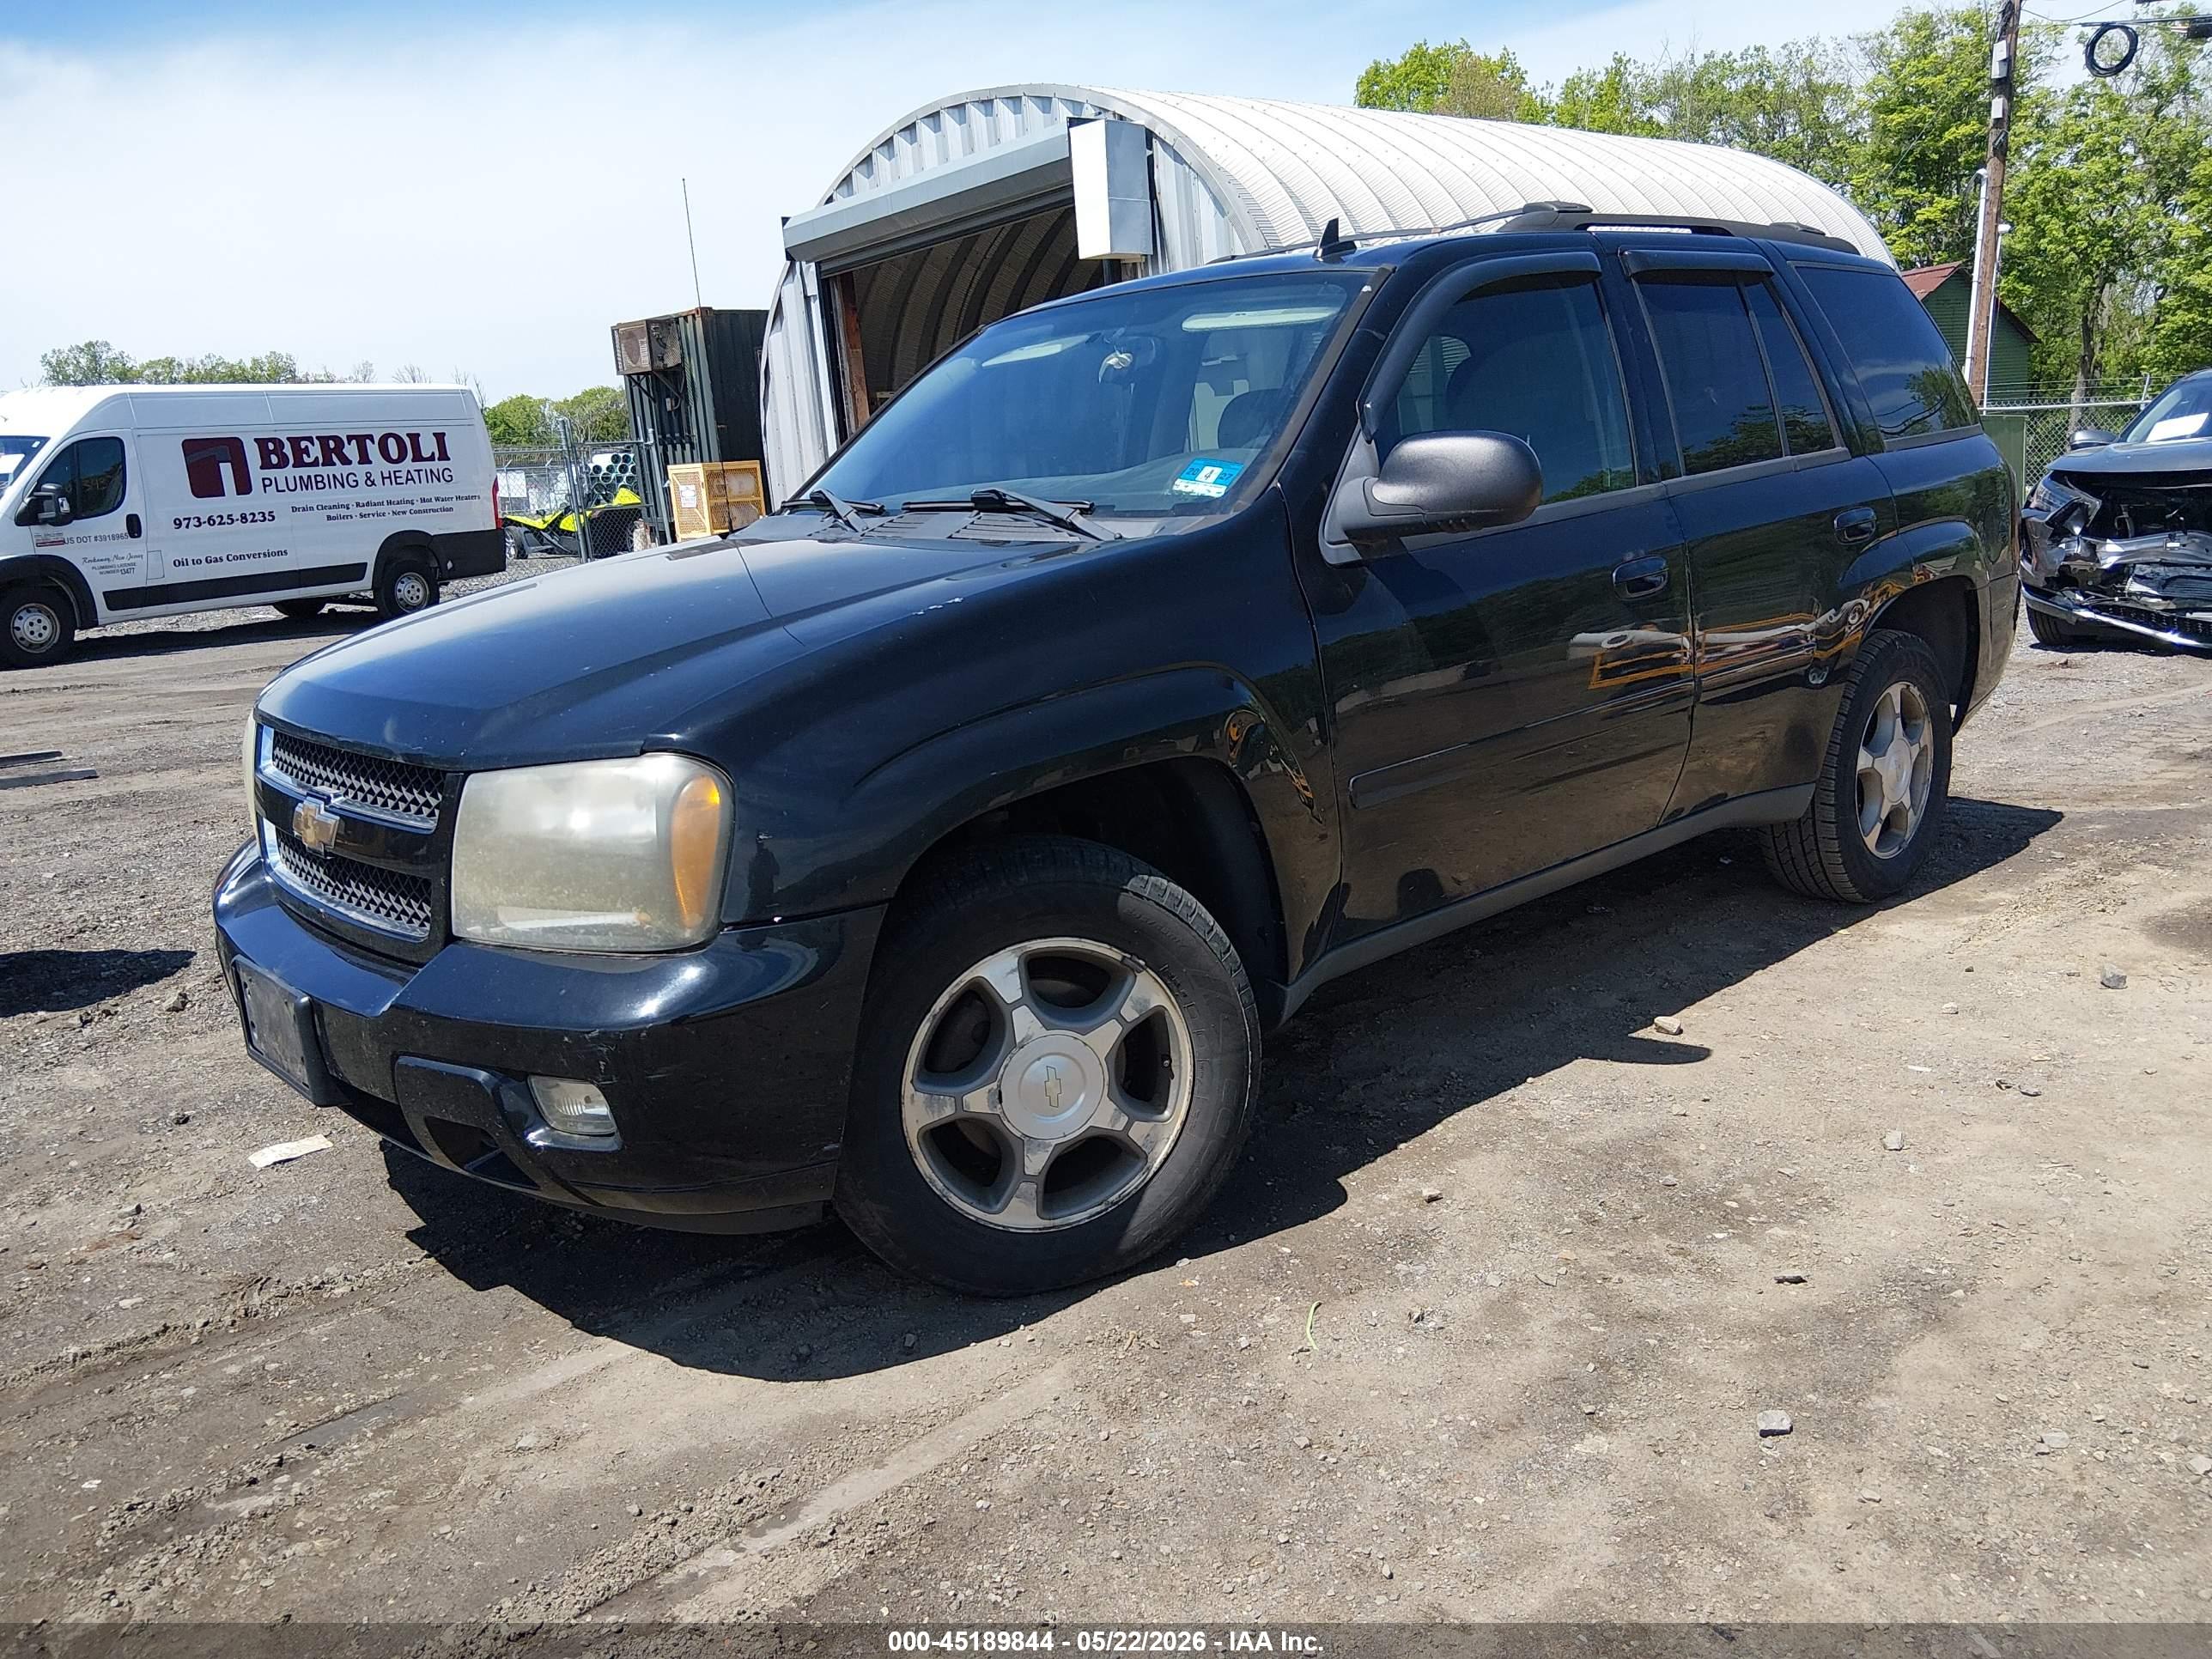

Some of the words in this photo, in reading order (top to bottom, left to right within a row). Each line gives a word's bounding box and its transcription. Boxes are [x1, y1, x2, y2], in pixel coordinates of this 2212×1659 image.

[253, 432, 451, 470] BERTOLI
[262, 471, 359, 494] PLUMBING
[364, 471, 377, 488] &
[380, 468, 453, 486] HEATING
[291, 505, 314, 514] Drain
[316, 502, 350, 513] Cleaning
[356, 500, 385, 508] Radiant
[386, 498, 414, 507] Heating
[434, 495, 453, 503] Water
[359, 511, 386, 520] Service
[392, 508, 407, 517] New
[409, 506, 453, 515] Construction
[173, 511, 276, 530] 973-625-8235
[76, 535, 92, 544] DOT
[173, 558, 189, 568] Oil
[191, 556, 203, 566] to
[204, 556, 223, 564] Gas
[226, 549, 289, 562] Conversions
